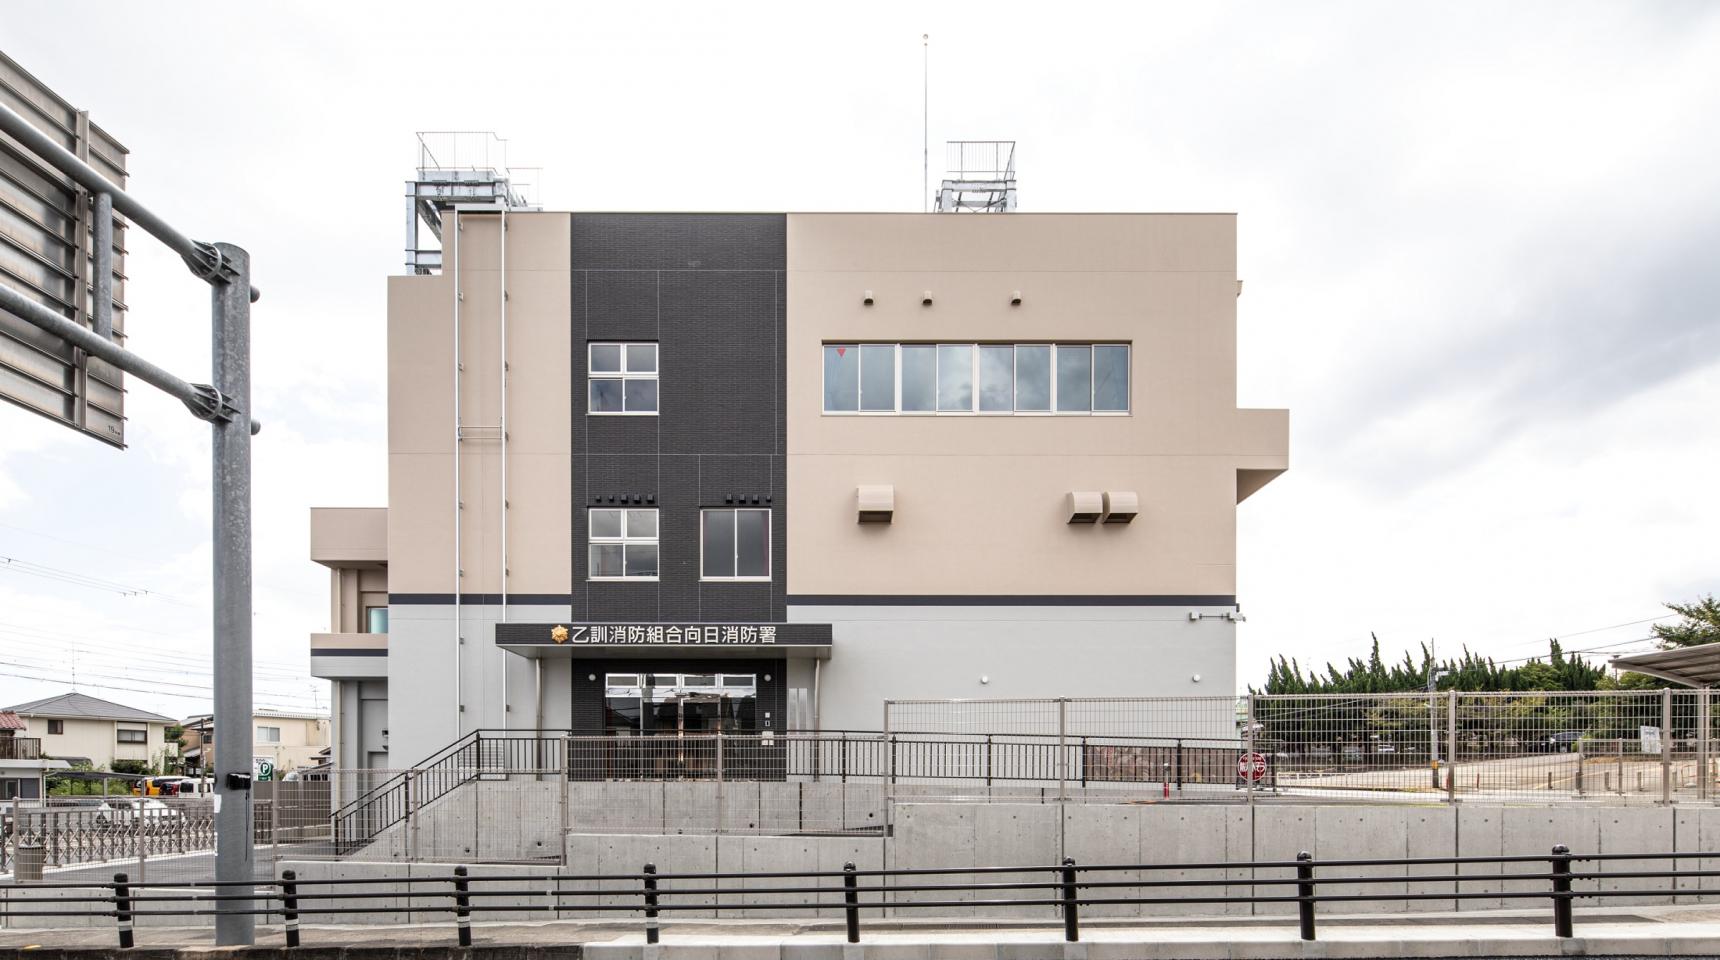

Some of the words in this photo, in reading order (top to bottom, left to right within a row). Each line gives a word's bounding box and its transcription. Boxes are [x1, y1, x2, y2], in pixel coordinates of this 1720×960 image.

[572, 626, 777, 644] 乙訓消防組合向日消防署
